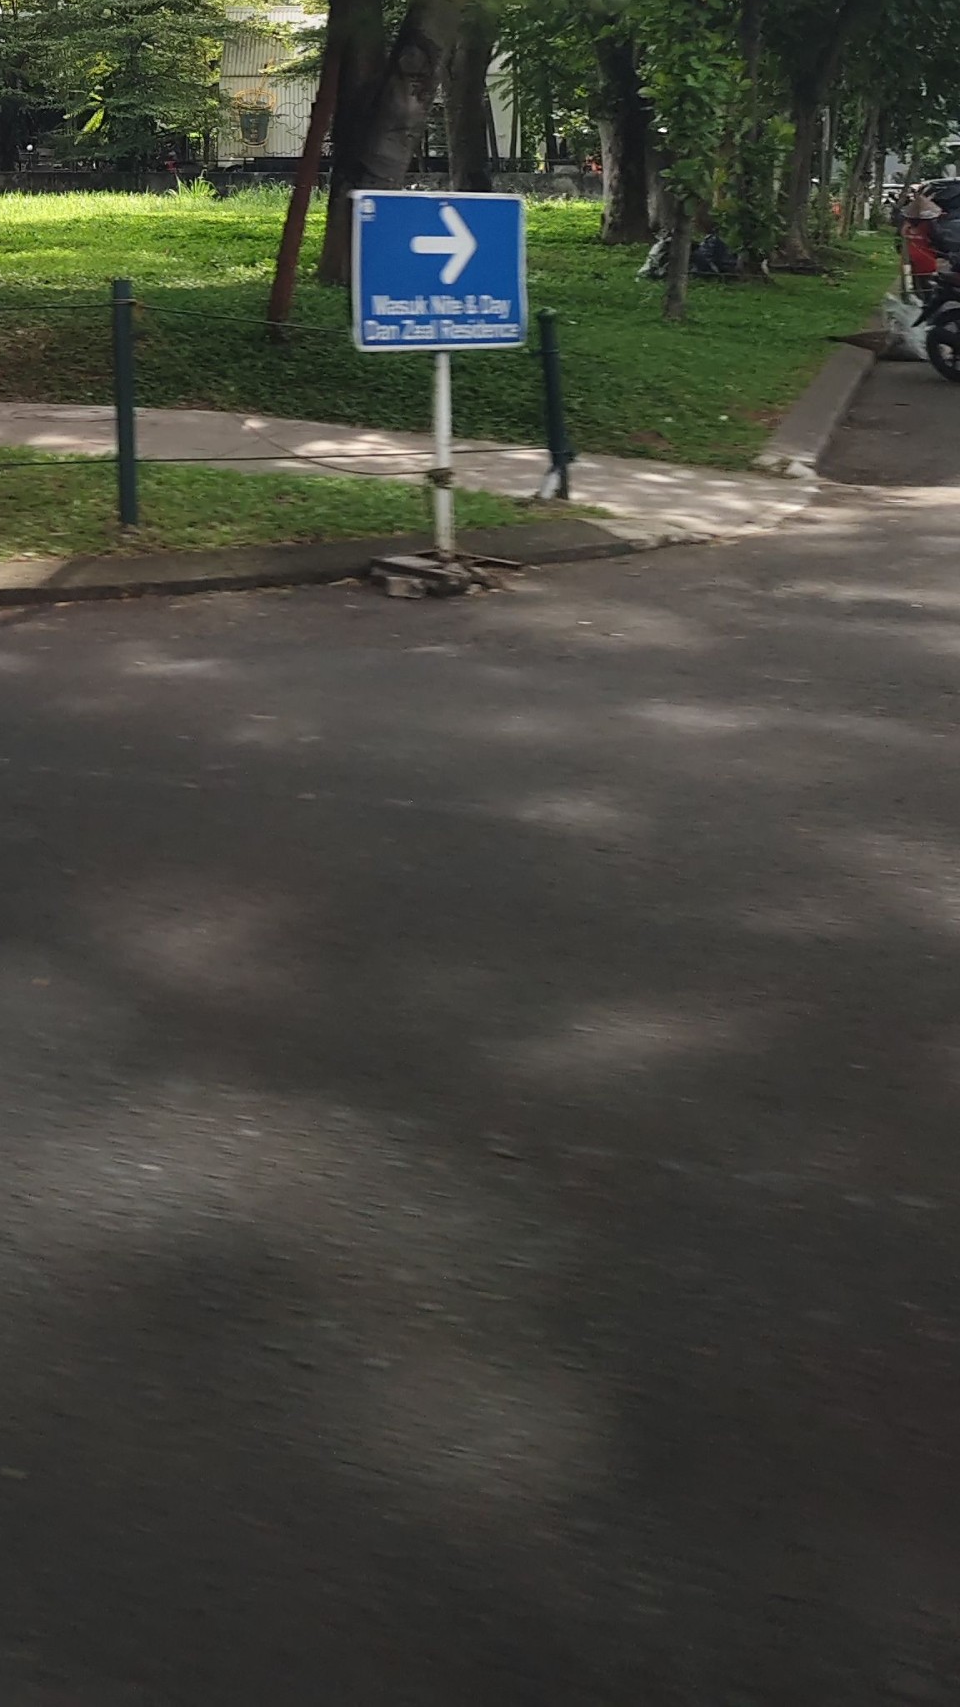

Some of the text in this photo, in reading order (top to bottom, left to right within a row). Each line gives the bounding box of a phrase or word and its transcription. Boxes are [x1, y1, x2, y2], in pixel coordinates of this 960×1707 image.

[371, 294, 511, 318] Masuk Nite & Day
[364, 320, 399, 340] Dan
[439, 319, 519, 339] Residence
